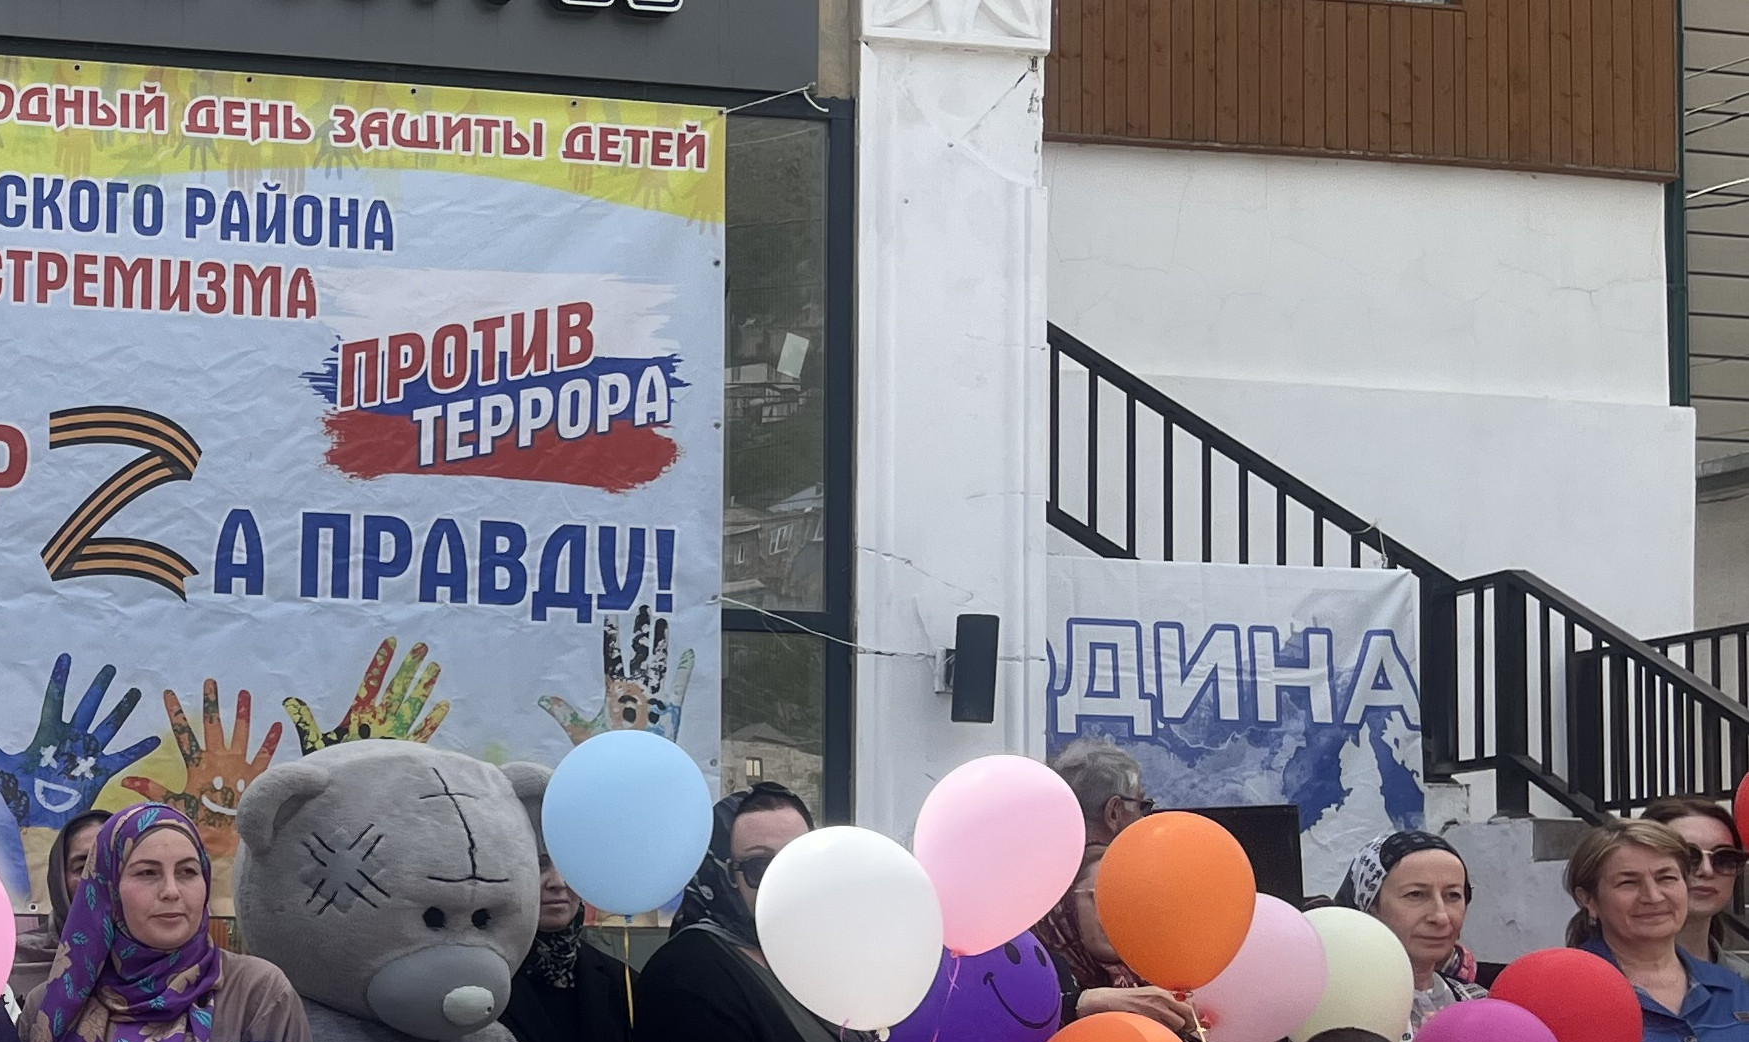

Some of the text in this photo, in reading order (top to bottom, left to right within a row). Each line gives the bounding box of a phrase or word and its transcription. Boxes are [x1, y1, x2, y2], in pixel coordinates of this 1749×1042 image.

[185, 99, 312, 142] ДЕНЬ
[333, 108, 543, 157] ЗАЩИТЫ
[562, 124, 705, 168] ДЕТЕЙ
[185, 181, 394, 251] РАЙОНА
[339, 301, 594, 409] ПРОТИВ
[412, 366, 670, 467] ТЕРРОРА
[300, 511, 675, 623] ПРАВДУ!
[1047, 617, 1422, 740] ДИНА
